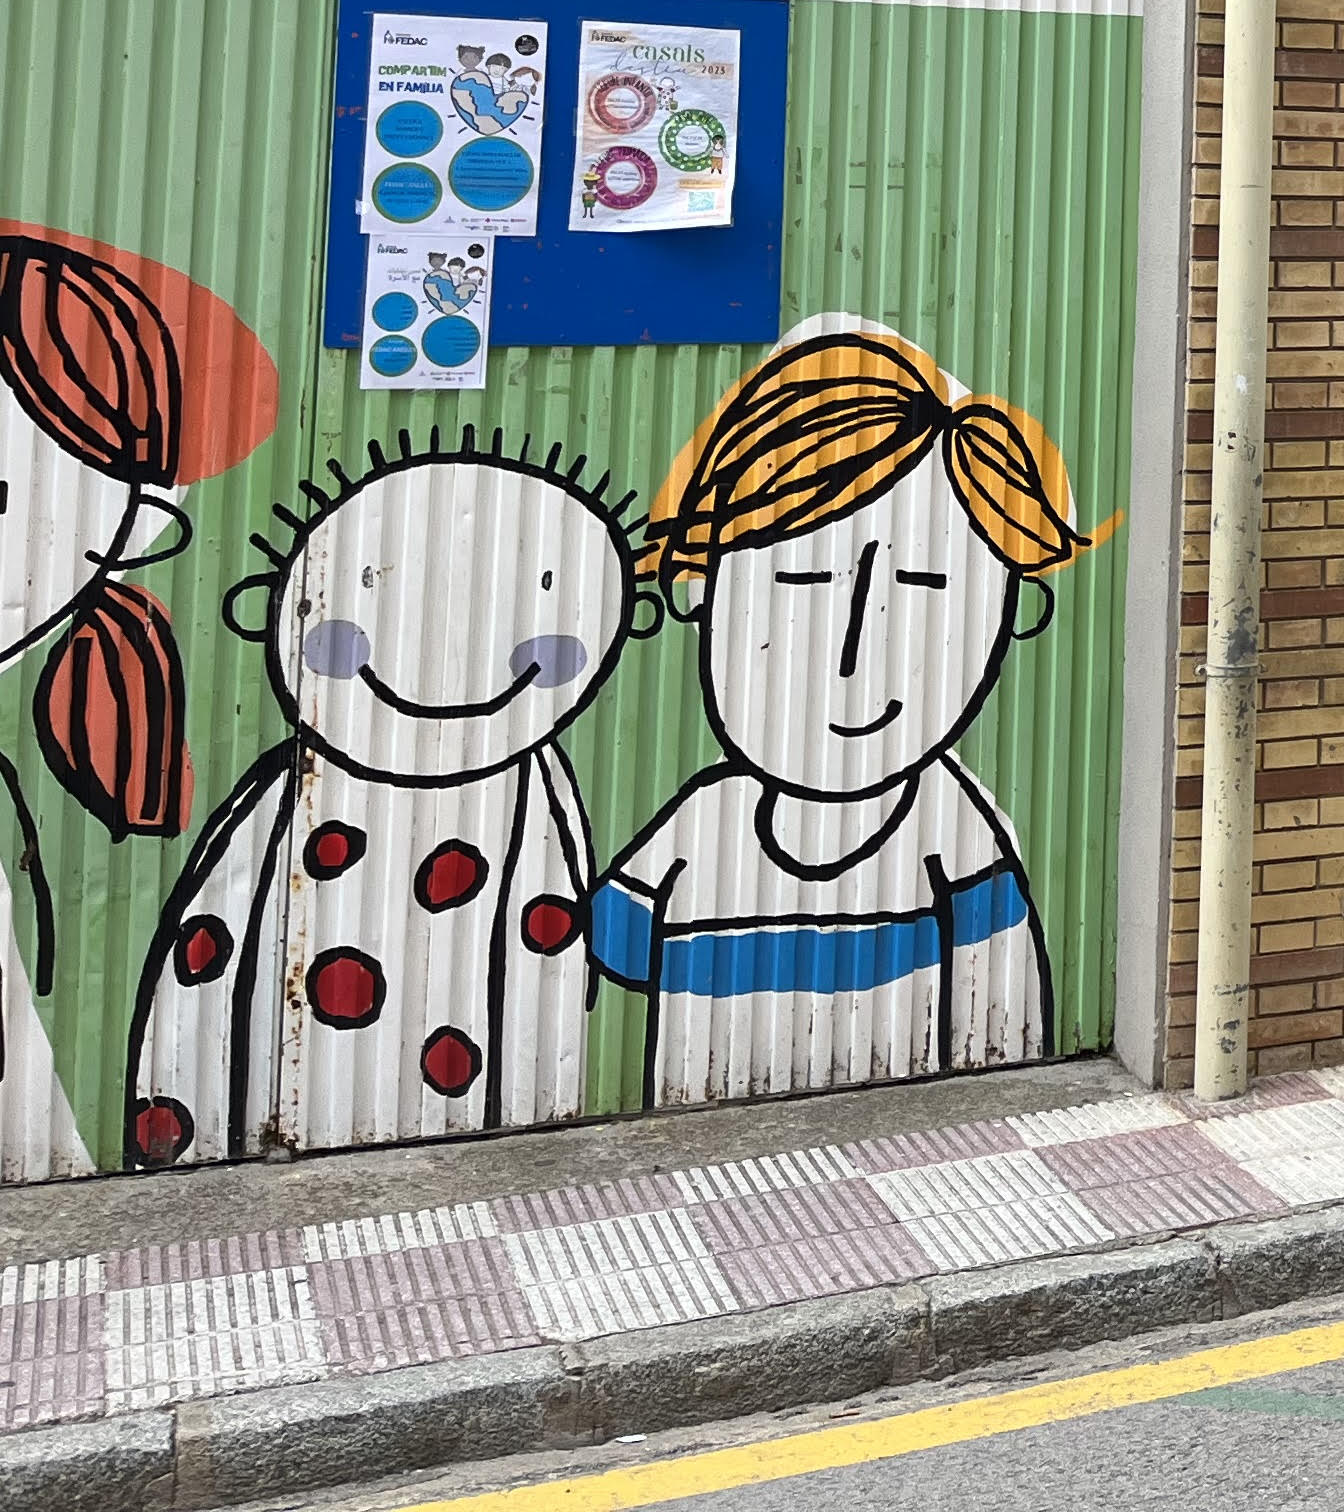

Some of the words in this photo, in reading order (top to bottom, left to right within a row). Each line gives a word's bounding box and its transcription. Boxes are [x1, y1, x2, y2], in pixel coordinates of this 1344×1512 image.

[395, 37, 428, 46] FEDAC
[632, 44, 706, 63] casals
[378, 65, 447, 77] COMPARTIM
[378, 81, 394, 92] EN
